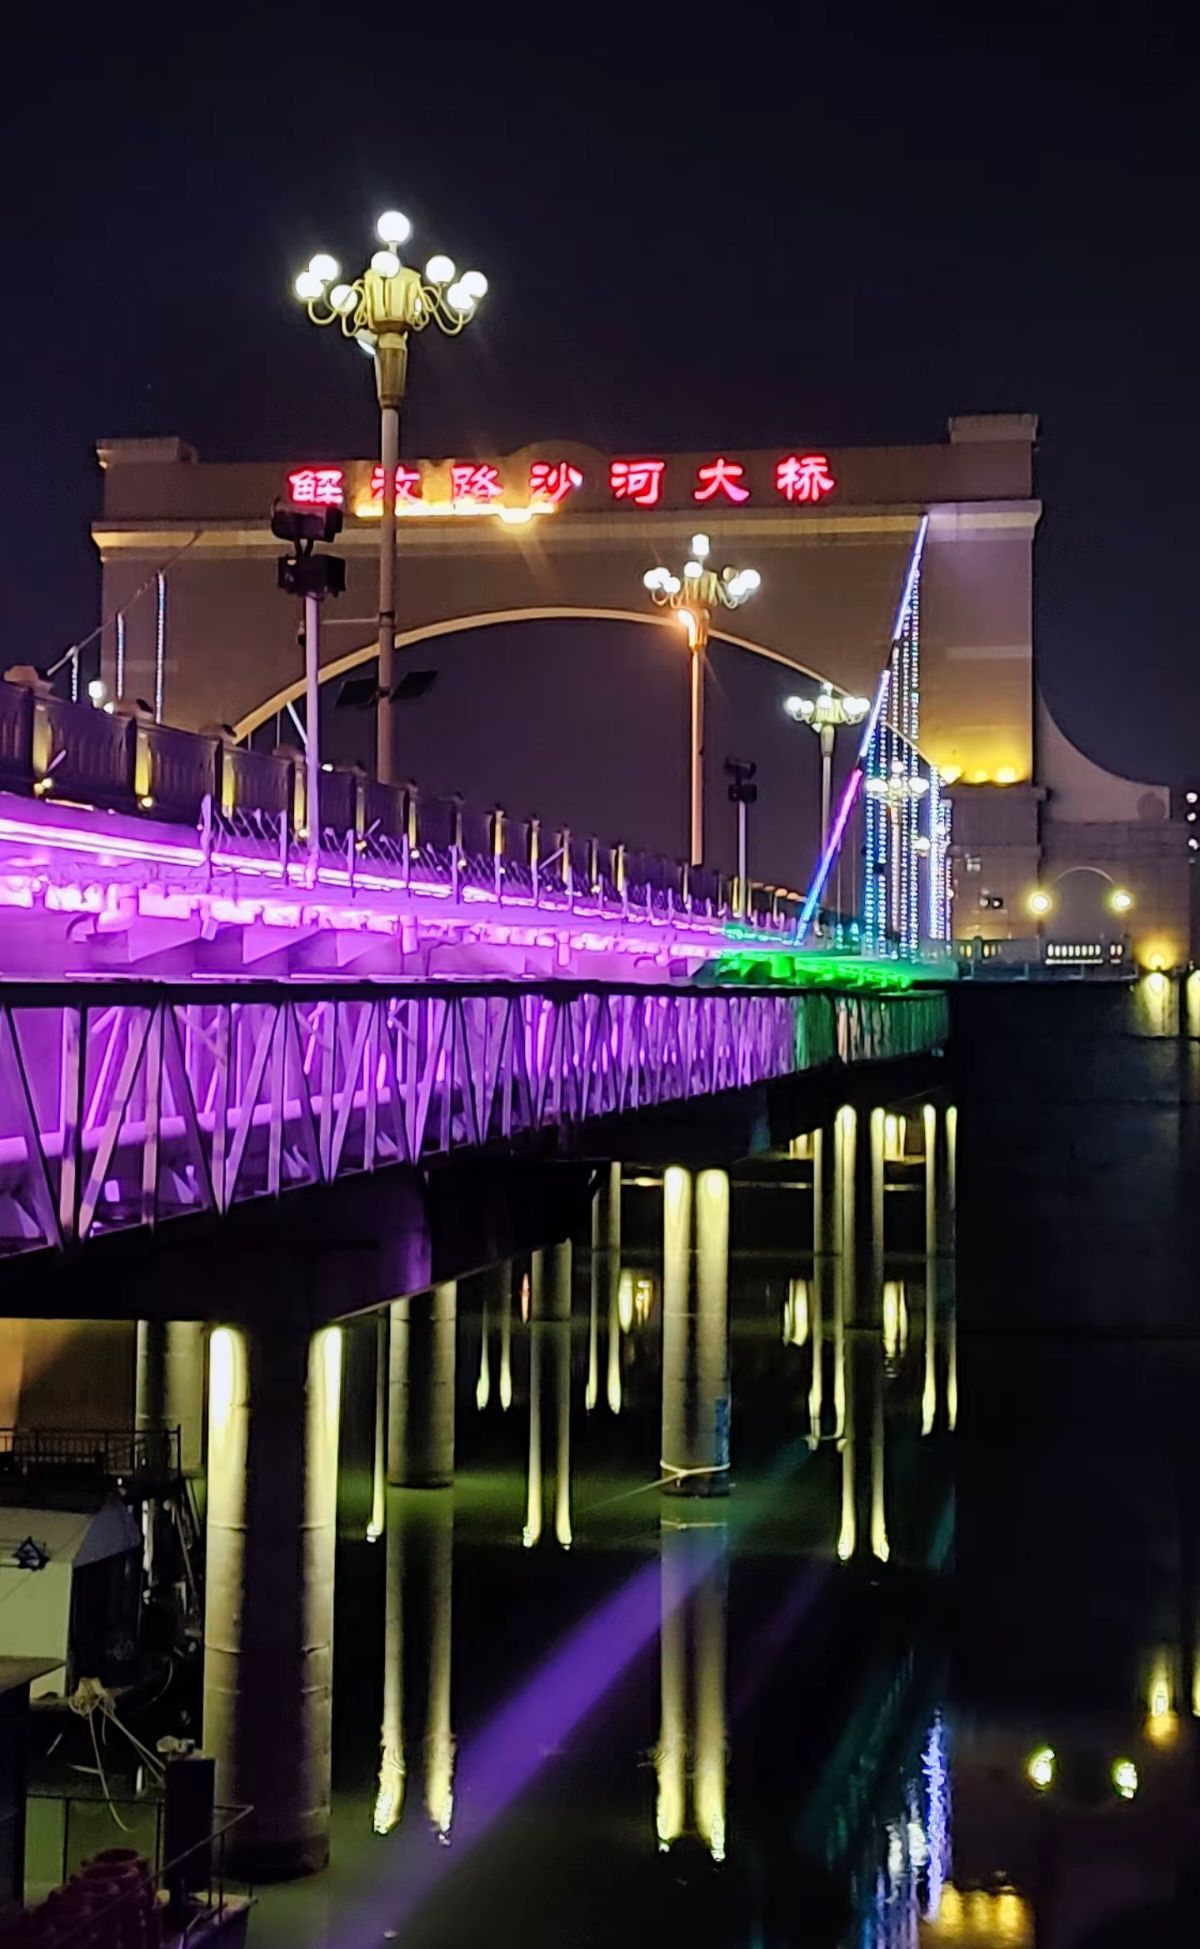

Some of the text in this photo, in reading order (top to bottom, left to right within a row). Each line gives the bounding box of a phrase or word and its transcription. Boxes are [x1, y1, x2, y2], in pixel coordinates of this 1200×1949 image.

[288, 454, 836, 505] 解放路沙河大桥
